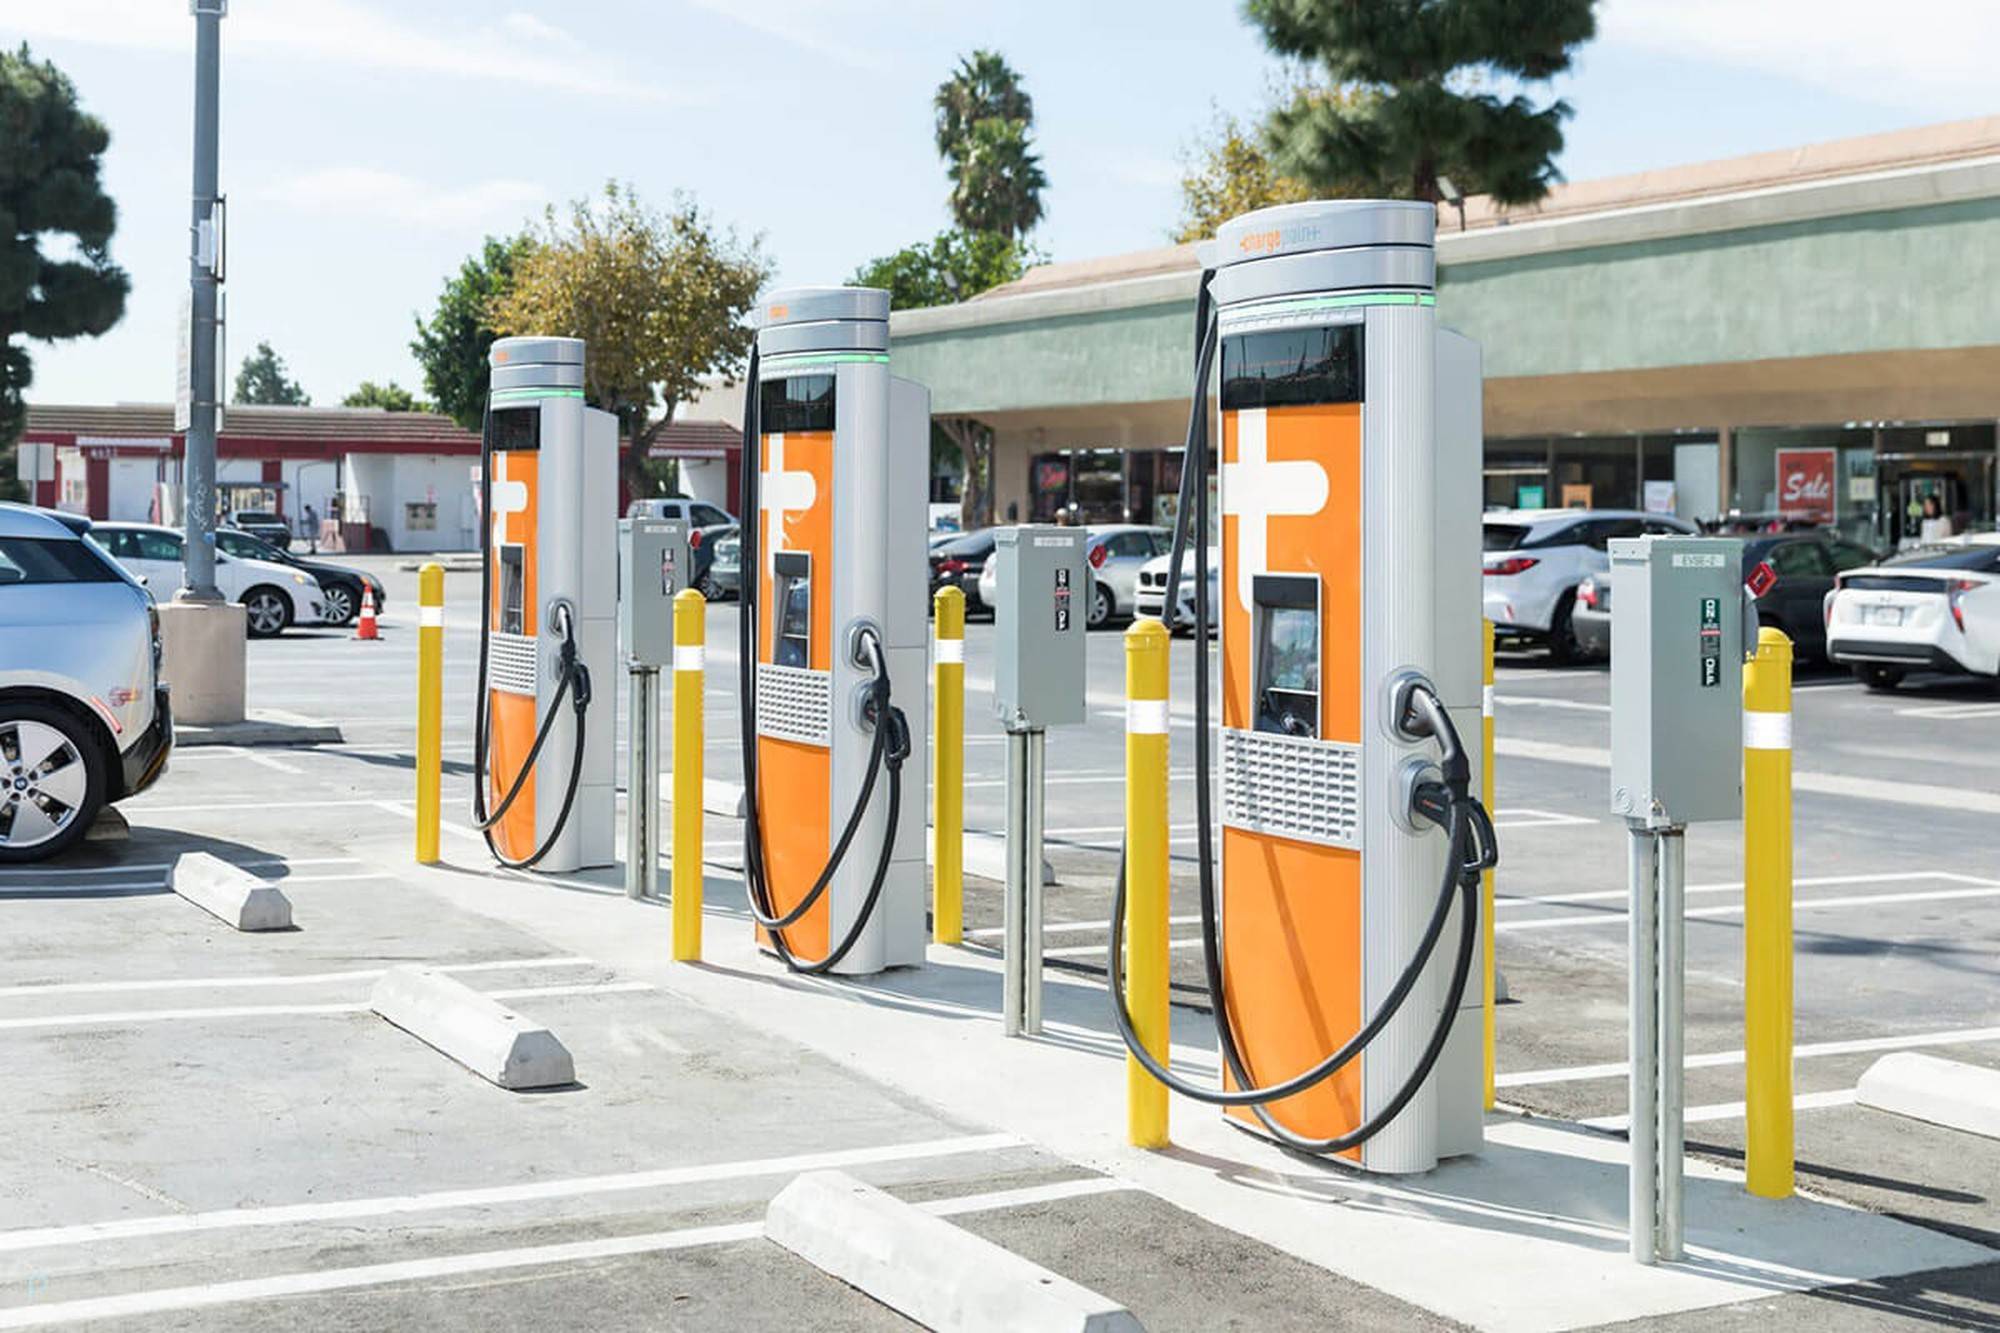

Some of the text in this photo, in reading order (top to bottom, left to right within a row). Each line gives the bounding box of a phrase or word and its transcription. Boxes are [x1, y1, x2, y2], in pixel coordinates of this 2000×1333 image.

[1783, 472, 1830, 502] Sale
[1705, 599, 1716, 618] ON
[1705, 658, 1716, 686] OFF
